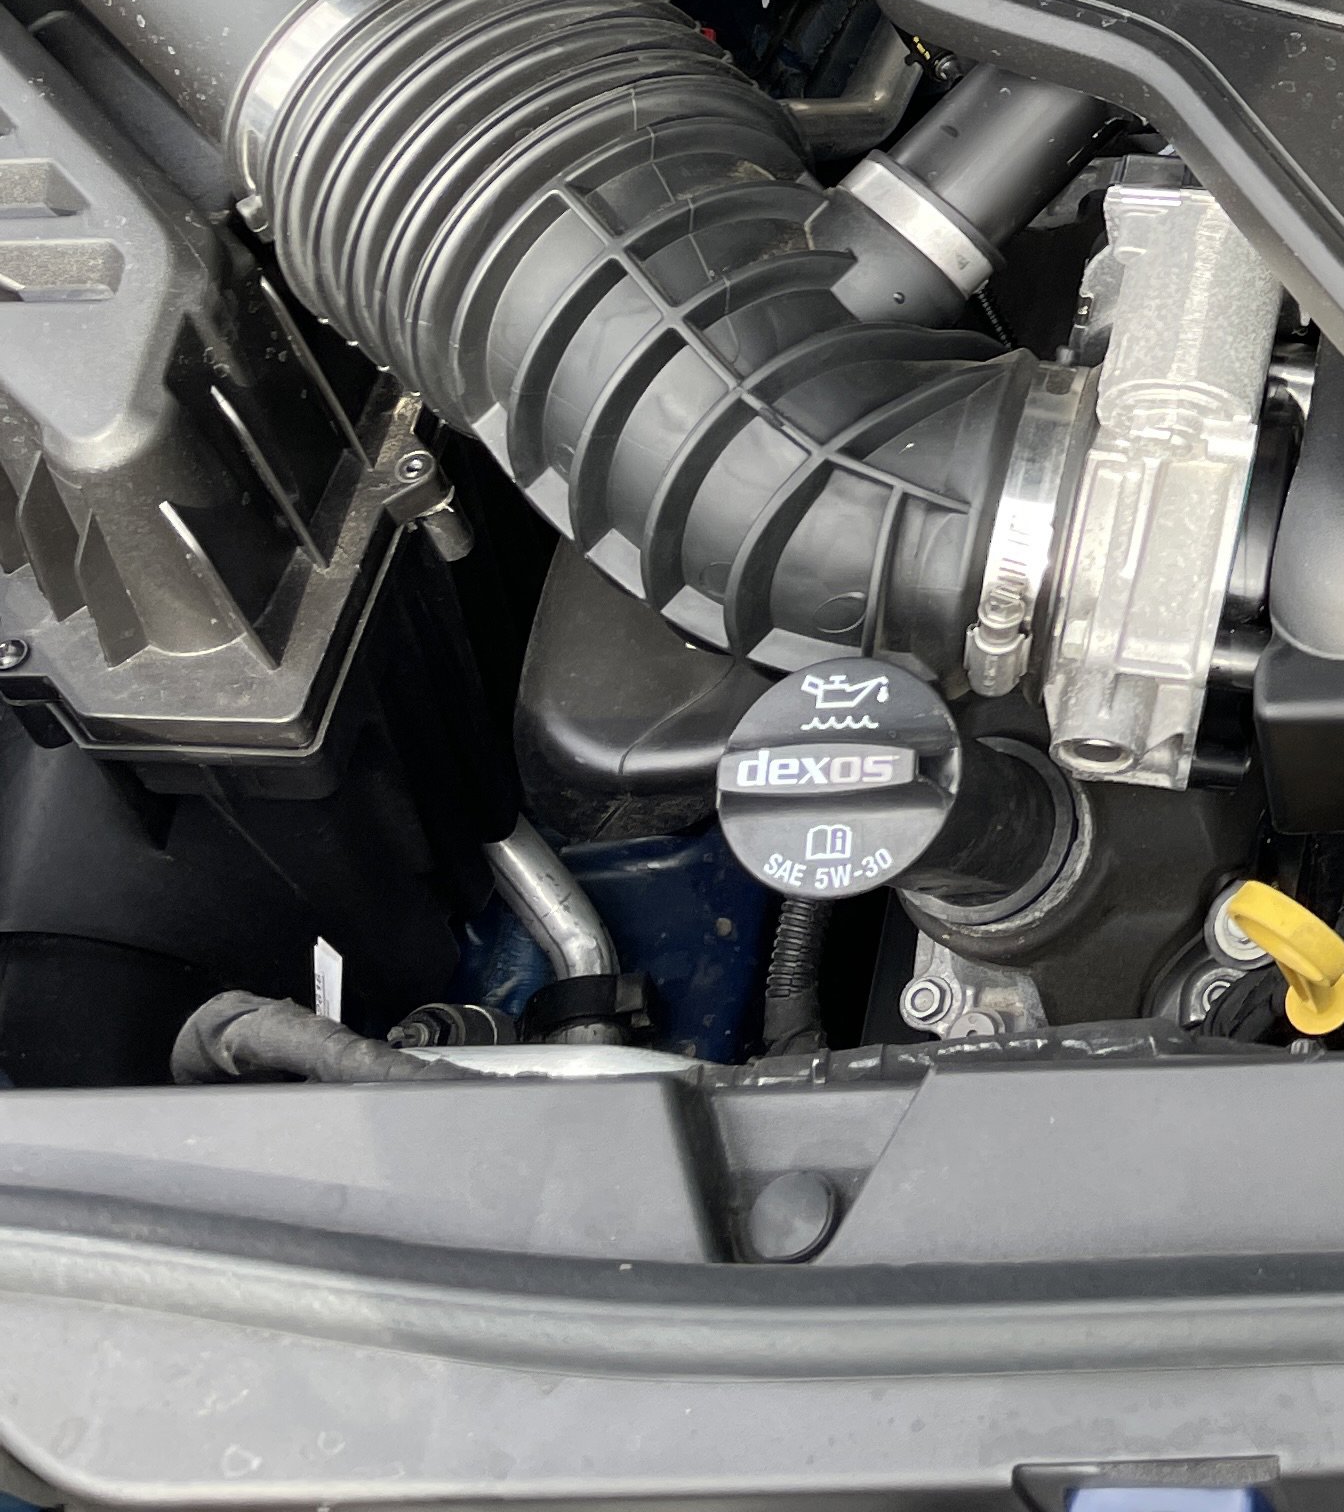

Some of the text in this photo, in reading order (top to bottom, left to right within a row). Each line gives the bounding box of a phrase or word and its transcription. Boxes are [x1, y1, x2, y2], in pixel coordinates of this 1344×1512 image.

[736, 748, 900, 787] dexos
[763, 847, 893, 889] SAE 5W-30
